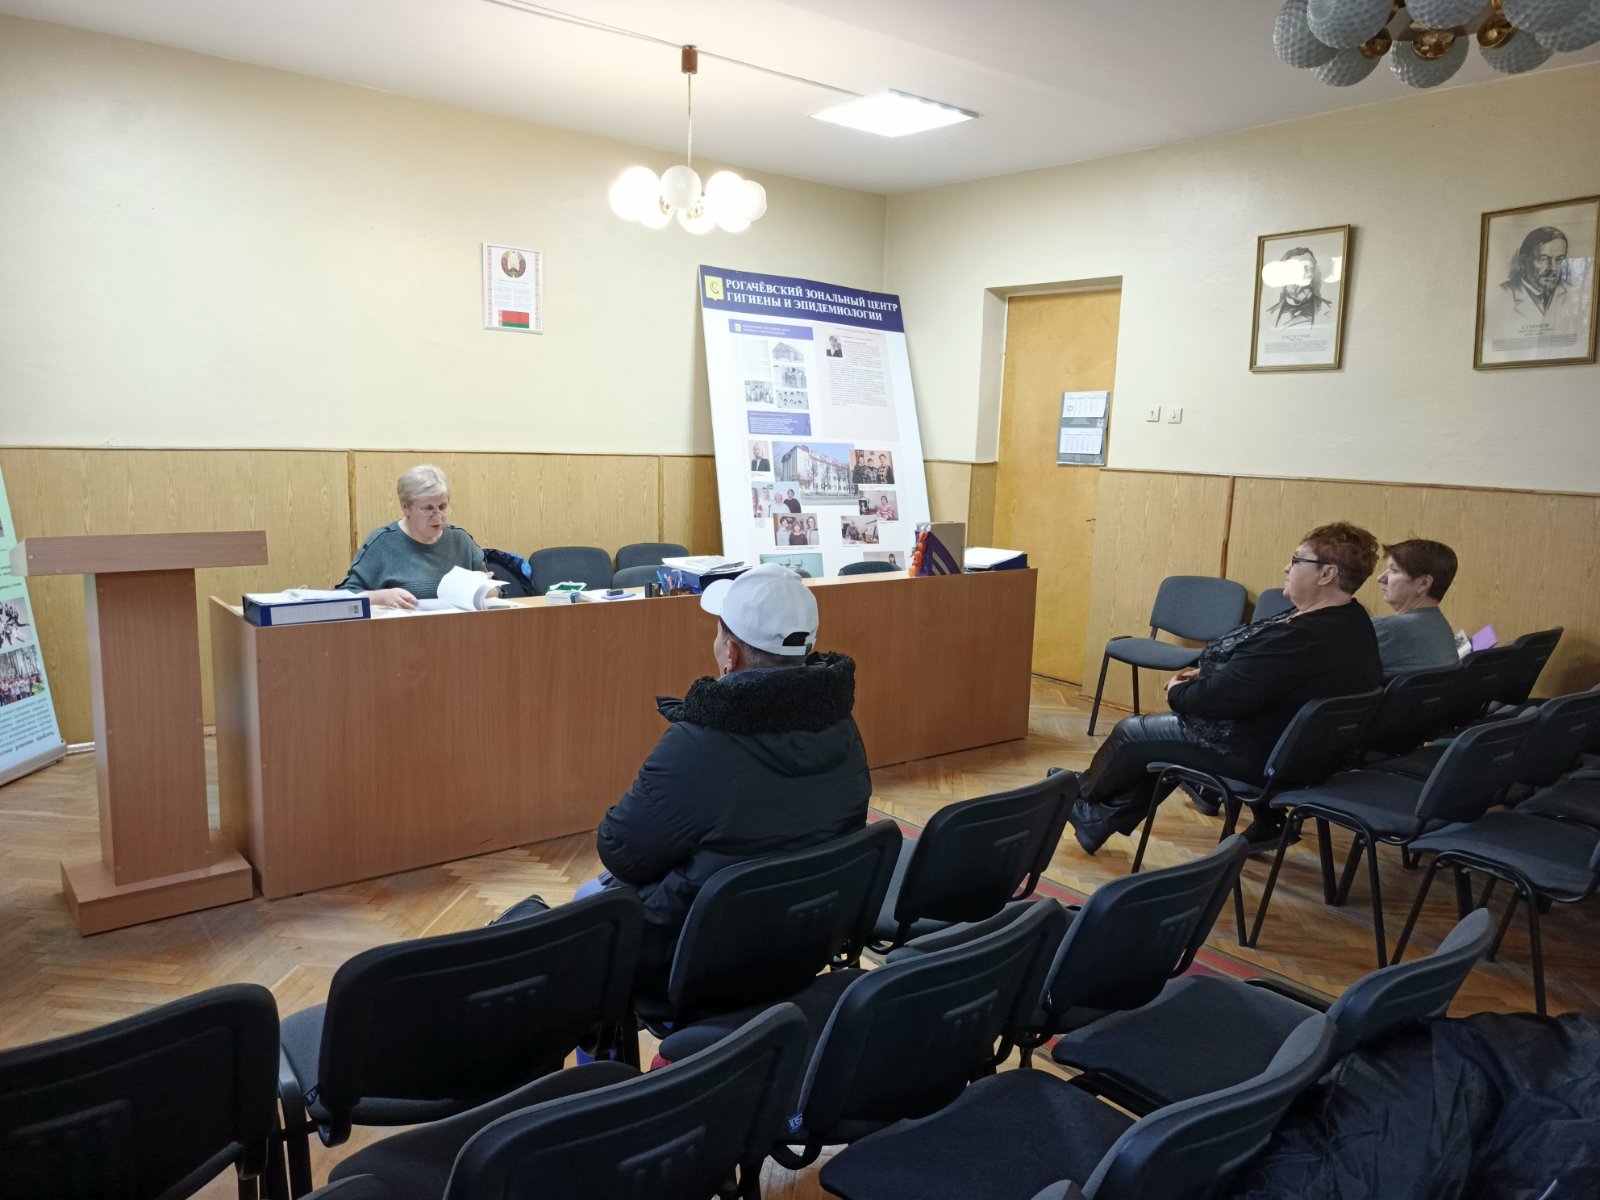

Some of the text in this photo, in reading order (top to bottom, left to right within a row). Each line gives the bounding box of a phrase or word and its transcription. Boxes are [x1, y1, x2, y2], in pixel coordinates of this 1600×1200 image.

[725, 278, 899, 312] РОГАЧЁВСКИЙ ЗОНАЛЬНЫЙ ЦЕНТР
[726, 291, 883, 321] ГИГИЕНЫ И ЭПИДЕМИОЛОГИИ
